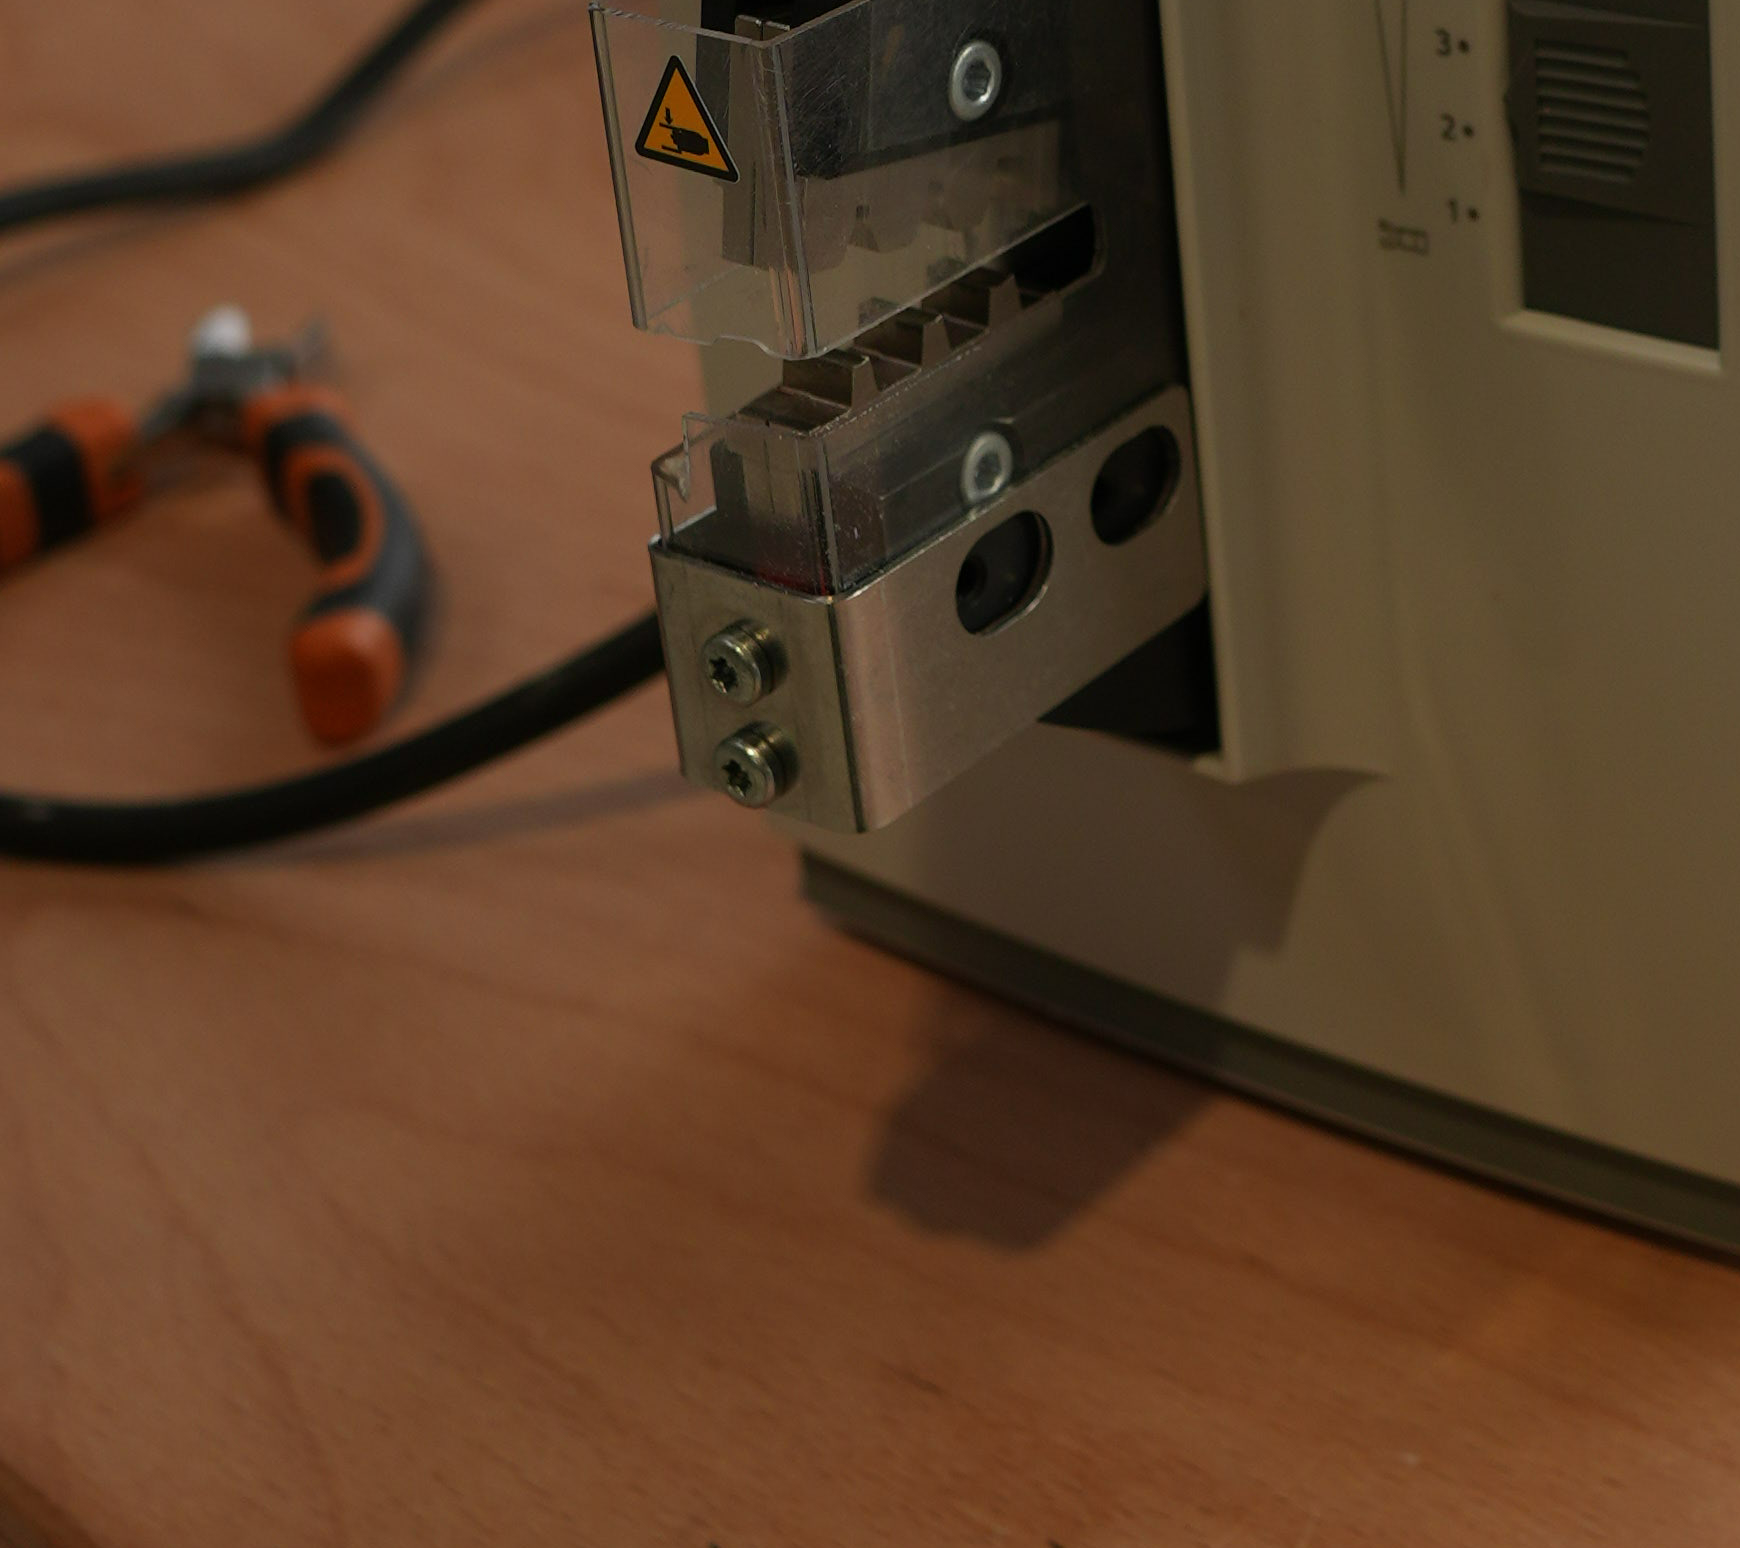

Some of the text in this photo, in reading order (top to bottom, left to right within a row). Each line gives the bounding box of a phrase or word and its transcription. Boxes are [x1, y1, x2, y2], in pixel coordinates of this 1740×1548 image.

[1435, 28, 1453, 56] 3
[1440, 114, 1456, 141] 2
[1447, 199, 1459, 224] 1
